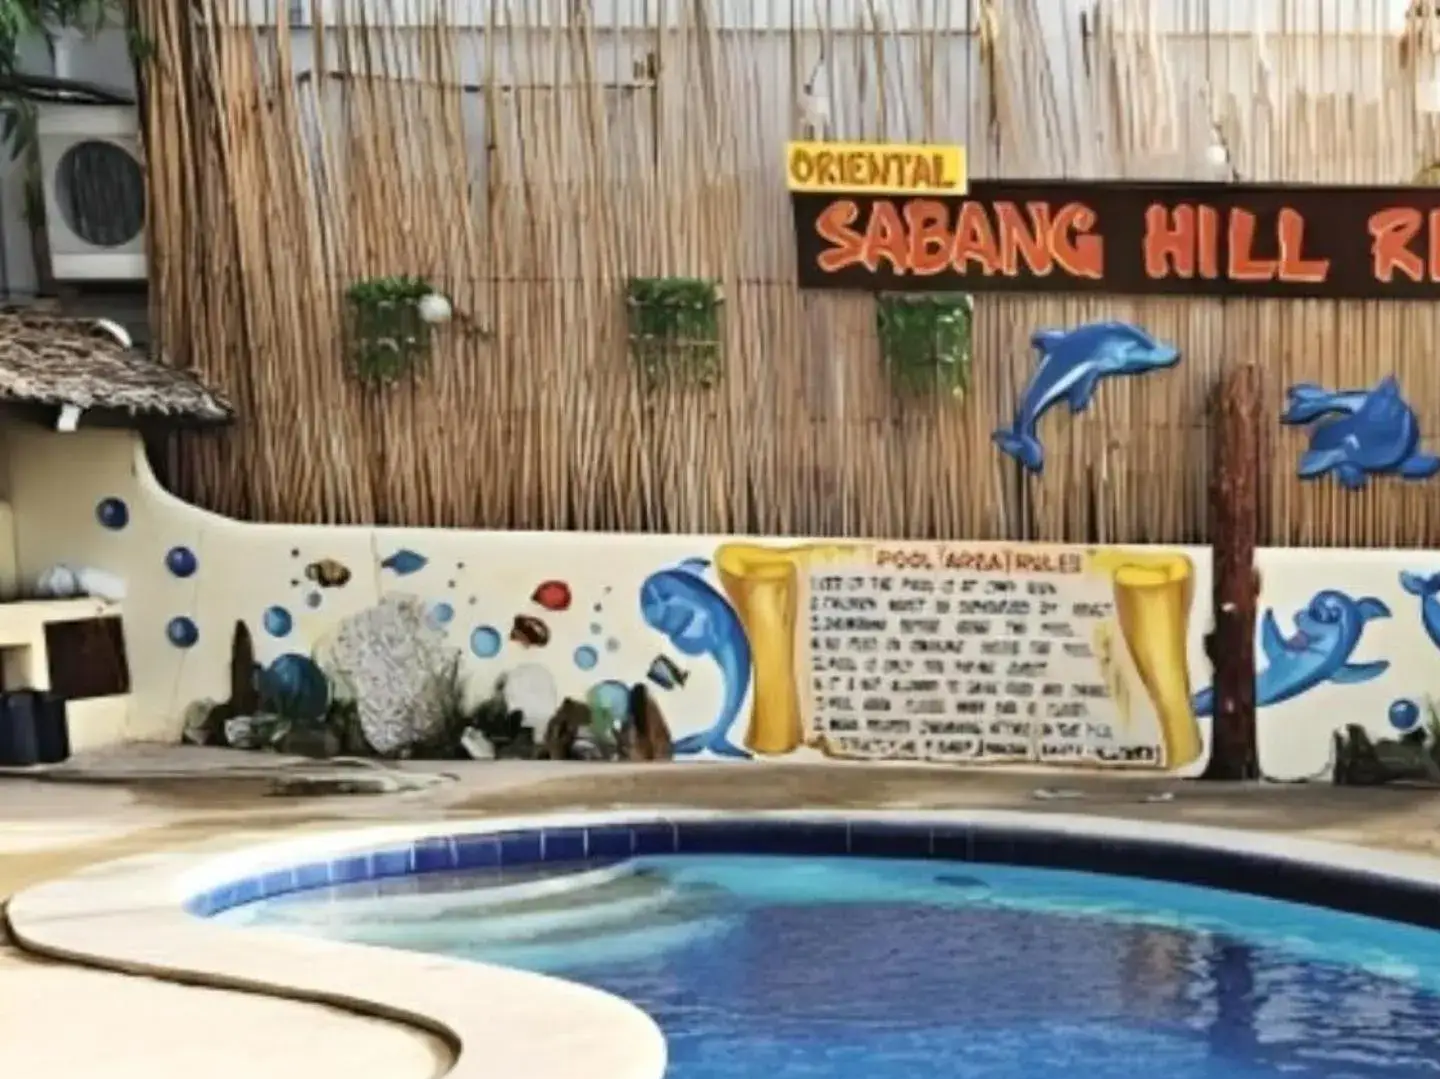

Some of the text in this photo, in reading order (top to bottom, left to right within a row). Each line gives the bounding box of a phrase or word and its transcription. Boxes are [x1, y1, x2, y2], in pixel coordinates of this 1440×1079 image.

[790, 147, 956, 189] ORIENTAL
[815, 200, 1104, 279] SABANG
[1143, 203, 1331, 283] HILL
[876, 549, 933, 571] POOL
